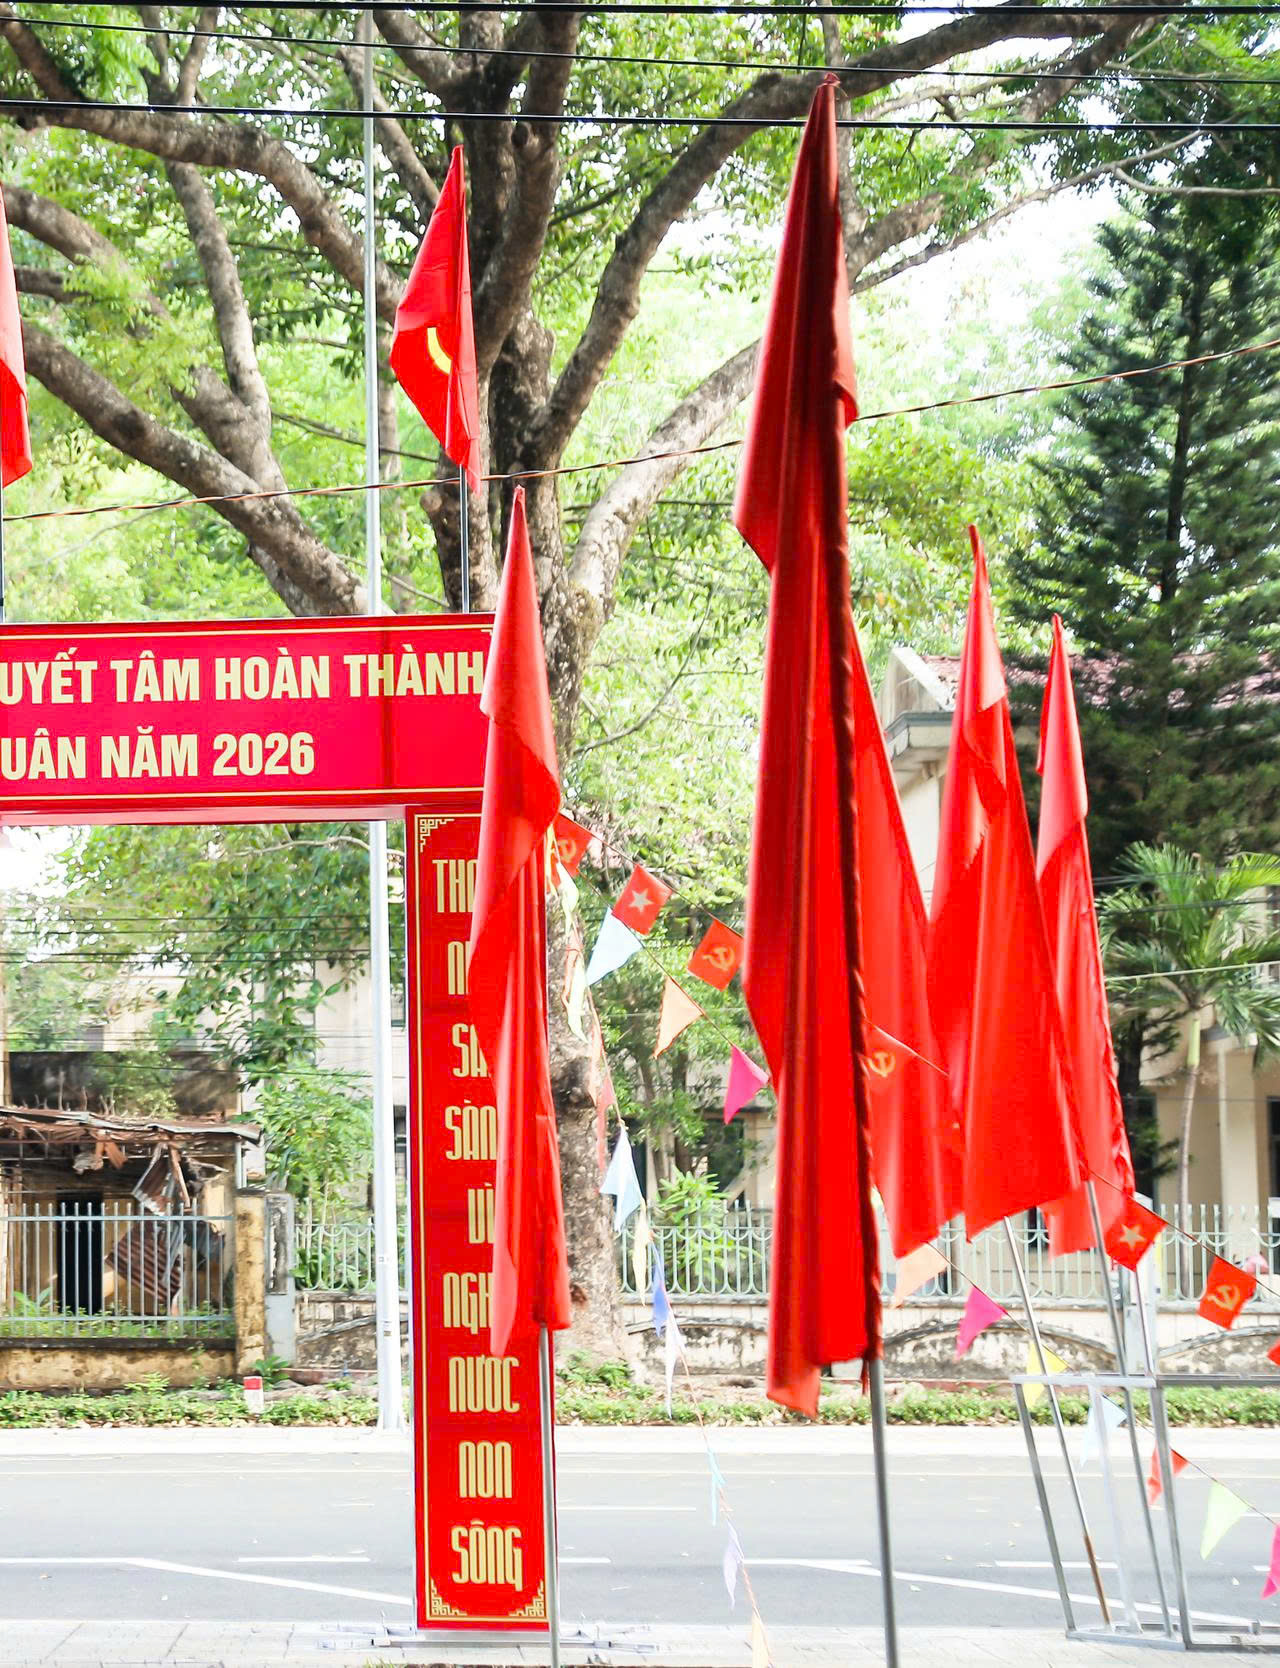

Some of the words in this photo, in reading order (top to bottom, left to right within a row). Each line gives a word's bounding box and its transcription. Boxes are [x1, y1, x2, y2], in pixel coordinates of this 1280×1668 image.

[109, 649, 201, 704] TÂM
[214, 647, 331, 701] HOÀN
[343, 644, 484, 698] THÀNH
[100, 726, 199, 779] NĂM
[212, 731, 315, 777] 2026
[445, 1099, 497, 1161] SÀN
[443, 1272, 494, 1335] NGH
[458, 1441, 513, 1499] NON
[451, 1520, 523, 1592] SÔNG
